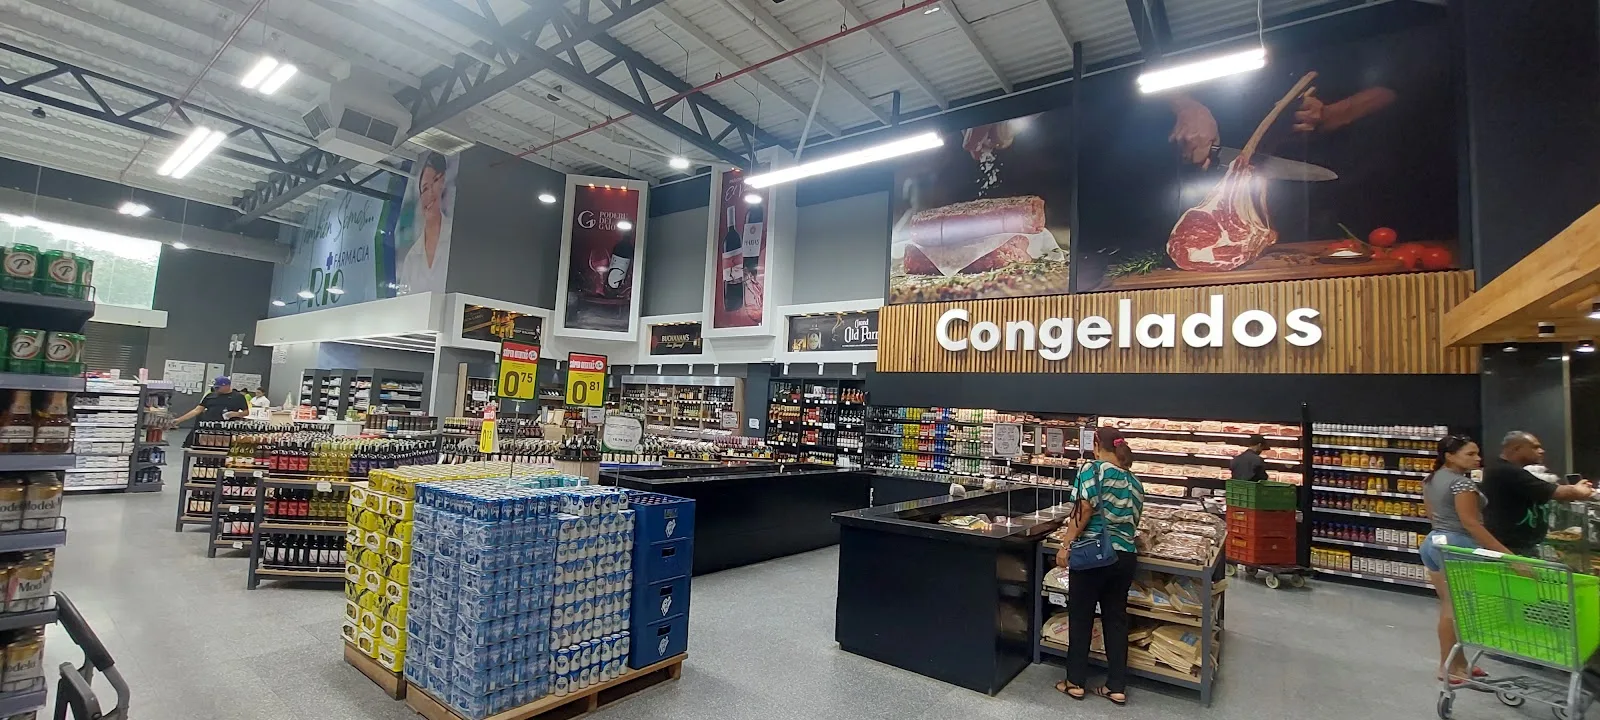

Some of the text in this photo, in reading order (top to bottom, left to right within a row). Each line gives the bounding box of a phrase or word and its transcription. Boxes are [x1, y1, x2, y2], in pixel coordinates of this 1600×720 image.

[333, 245, 370, 268] FARMACIA
[661, 333, 690, 342] BUCHANAN'S
[844, 326, 860, 343] Old
[935, 294, 1323, 361] Congelados
